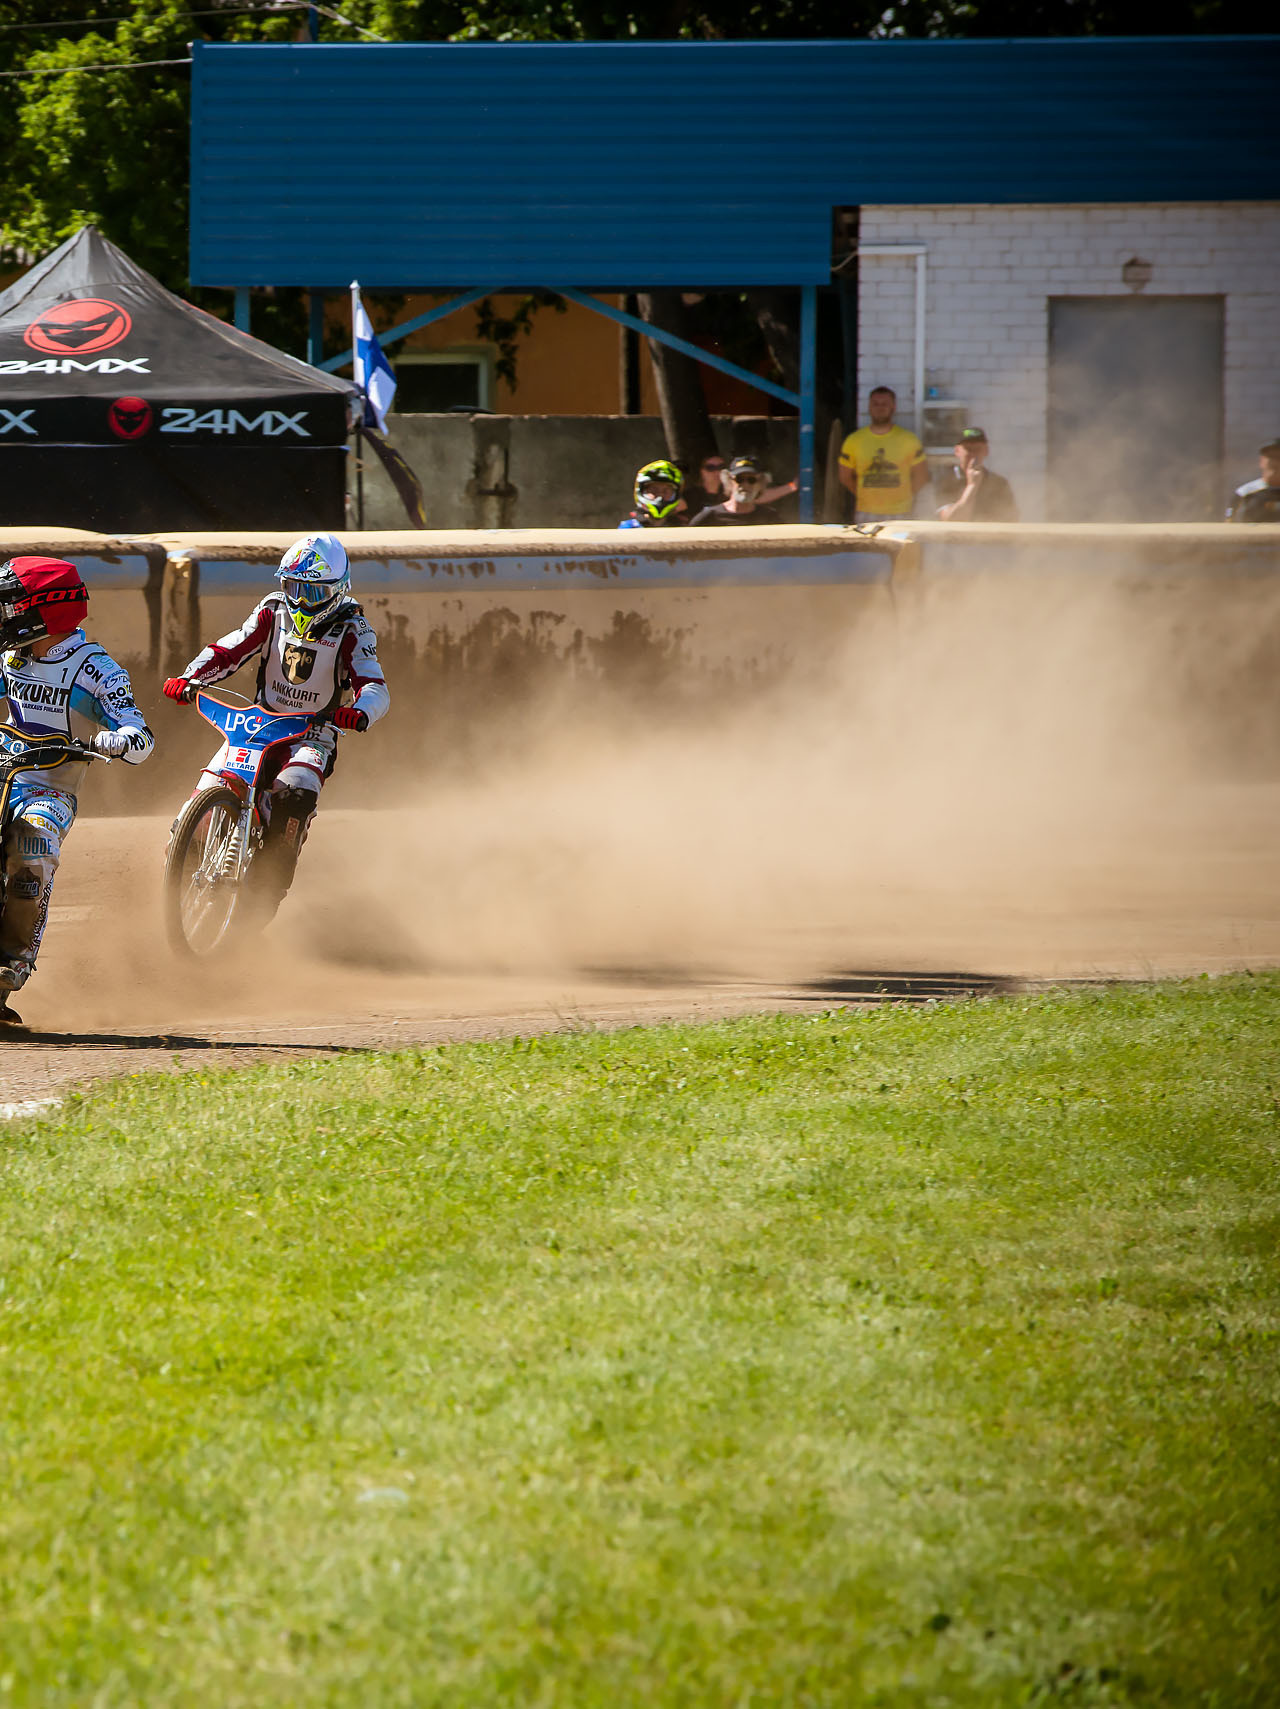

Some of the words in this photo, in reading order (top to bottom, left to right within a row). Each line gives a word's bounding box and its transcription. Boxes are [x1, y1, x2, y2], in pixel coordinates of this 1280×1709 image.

[159, 407, 312, 437] 24MX
[14, 586, 87, 614] SCOTT
[61, 667, 69, 684] 1
[272, 680, 320, 704] ANKKURIT
[275, 696, 303, 709] VARKAUS
[224, 712, 260, 734] LPG
[226, 761, 256, 772] BETARD
